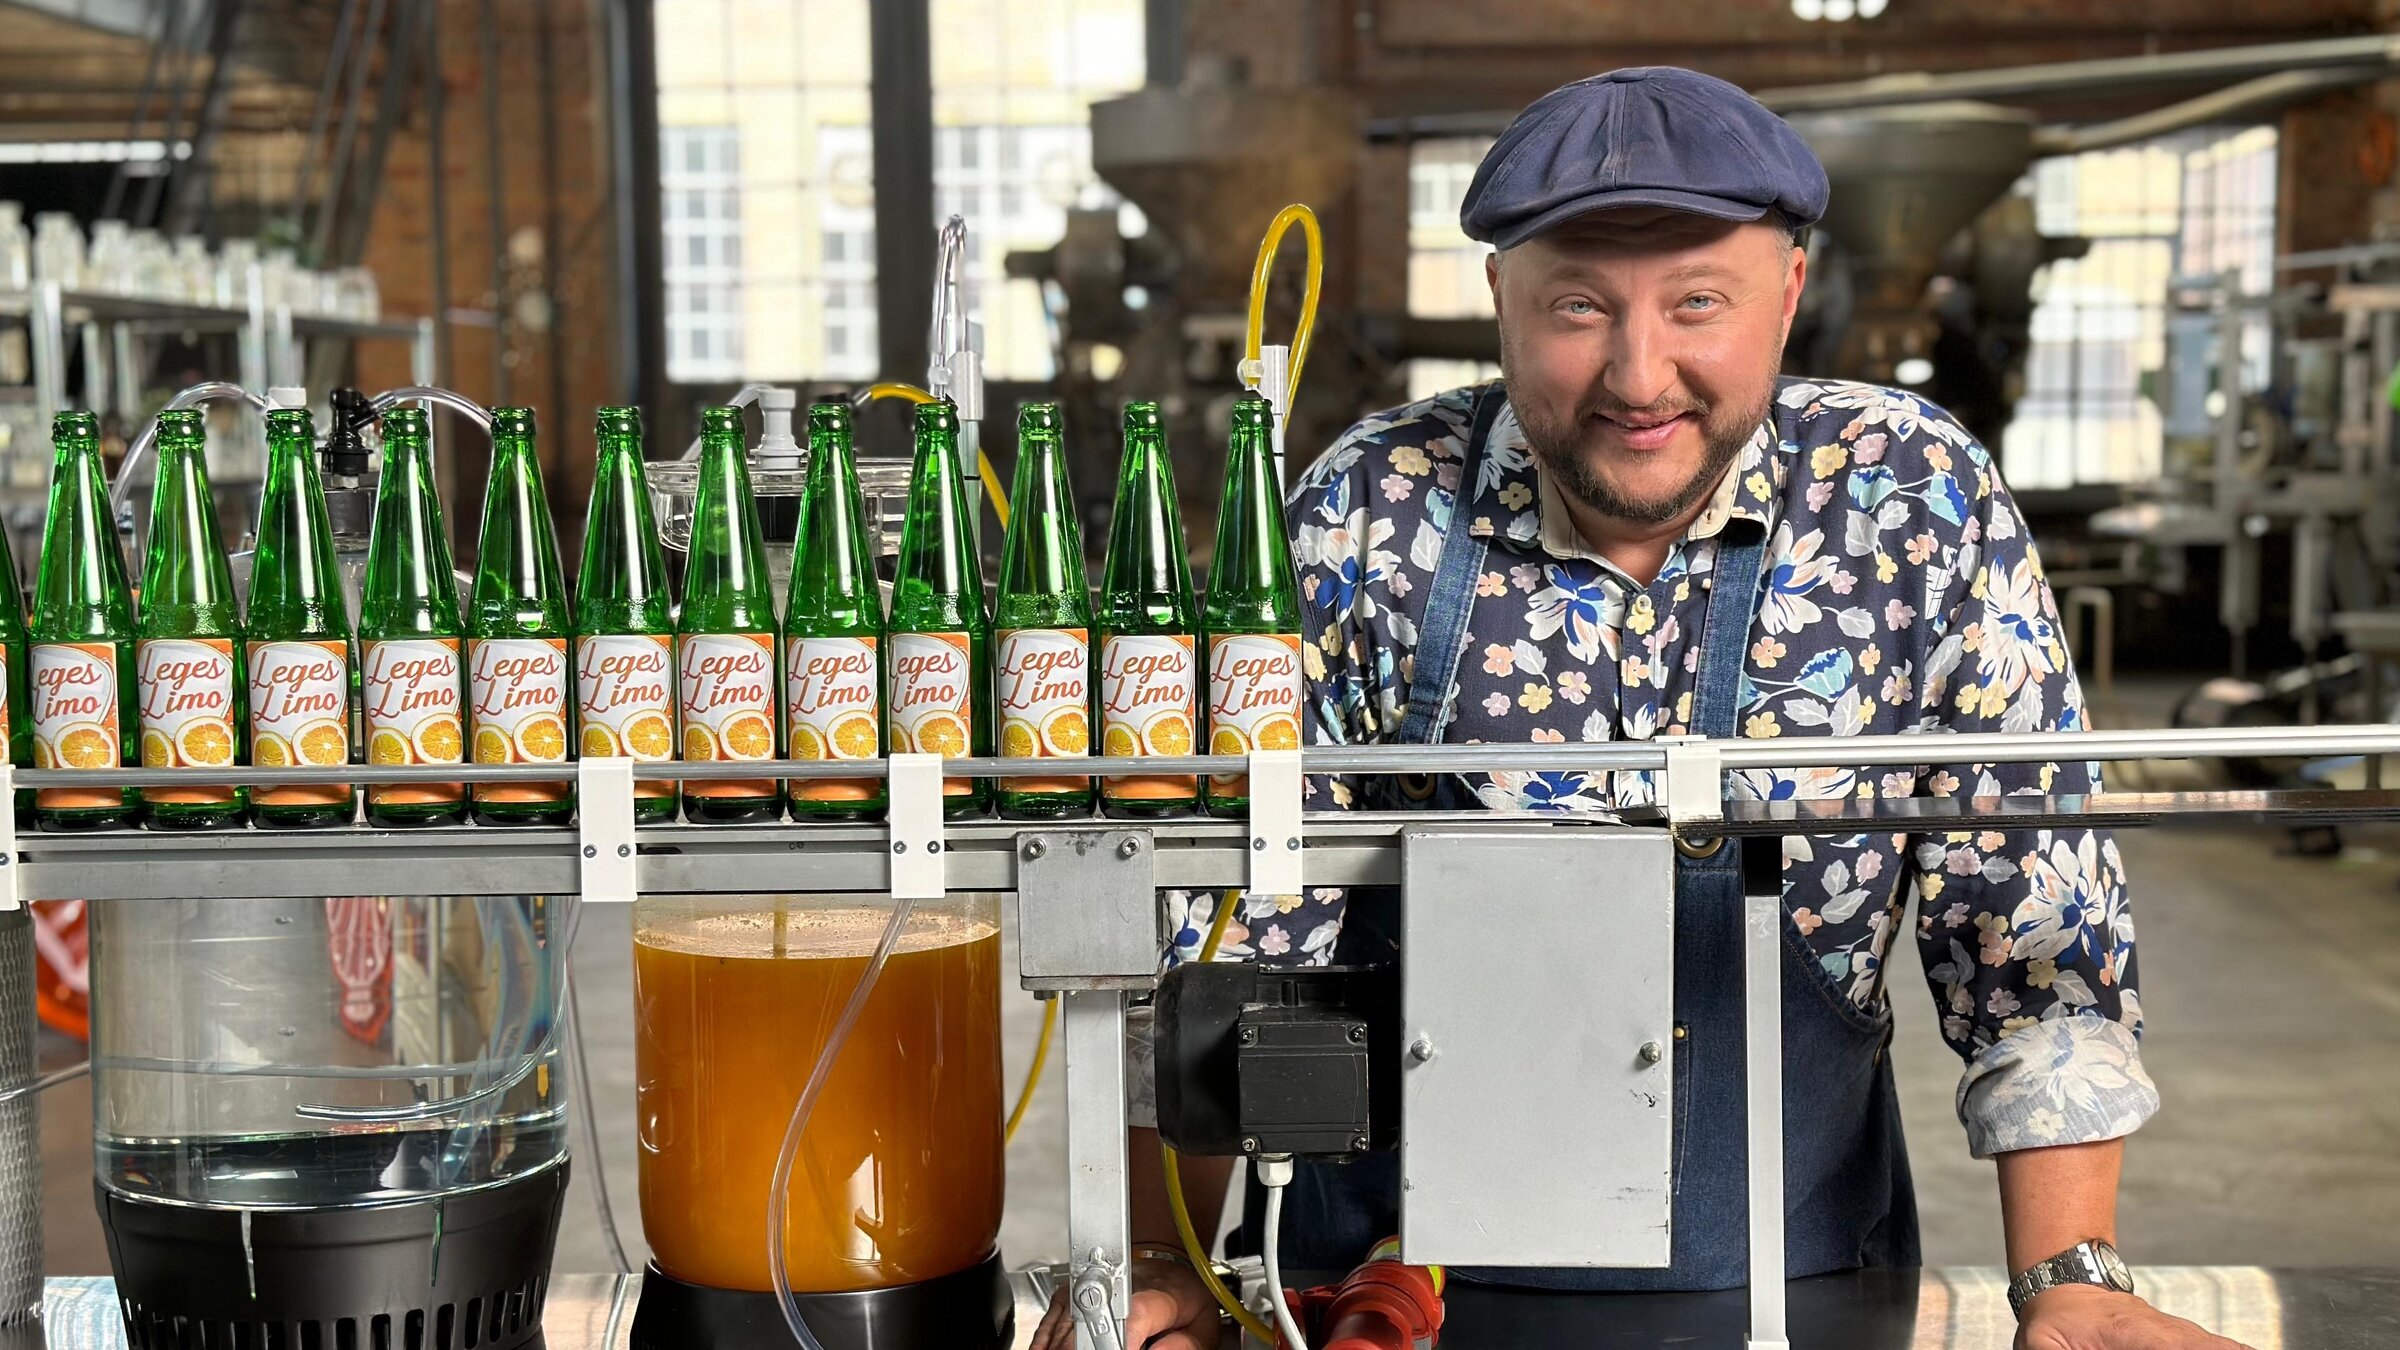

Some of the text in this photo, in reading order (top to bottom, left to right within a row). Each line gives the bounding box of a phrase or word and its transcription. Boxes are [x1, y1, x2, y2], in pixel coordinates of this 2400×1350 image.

[139, 648, 226, 690] Leges
[251, 651, 339, 693] Leges
[367, 647, 456, 689] Leges
[472, 645, 559, 687] Leges
[579, 642, 665, 684] Leges
[682, 642, 765, 685] Leges
[788, 643, 873, 685] Leges
[999, 638, 1085, 680] Leges
[1102, 642, 1187, 684] Leges
[1209, 645, 1295, 687] Leges
[141, 683, 224, 720] Limo
[252, 685, 339, 723] Limo
[370, 682, 455, 719] Limo
[474, 679, 559, 716] Limo
[580, 676, 665, 713] Limo
[683, 677, 765, 714] Limo
[790, 677, 872, 715] Limo
[890, 677, 957, 714] Limo
[1001, 673, 1084, 710] Limo
[1103, 676, 1186, 713] Limo
[1211, 679, 1294, 716] Limo
